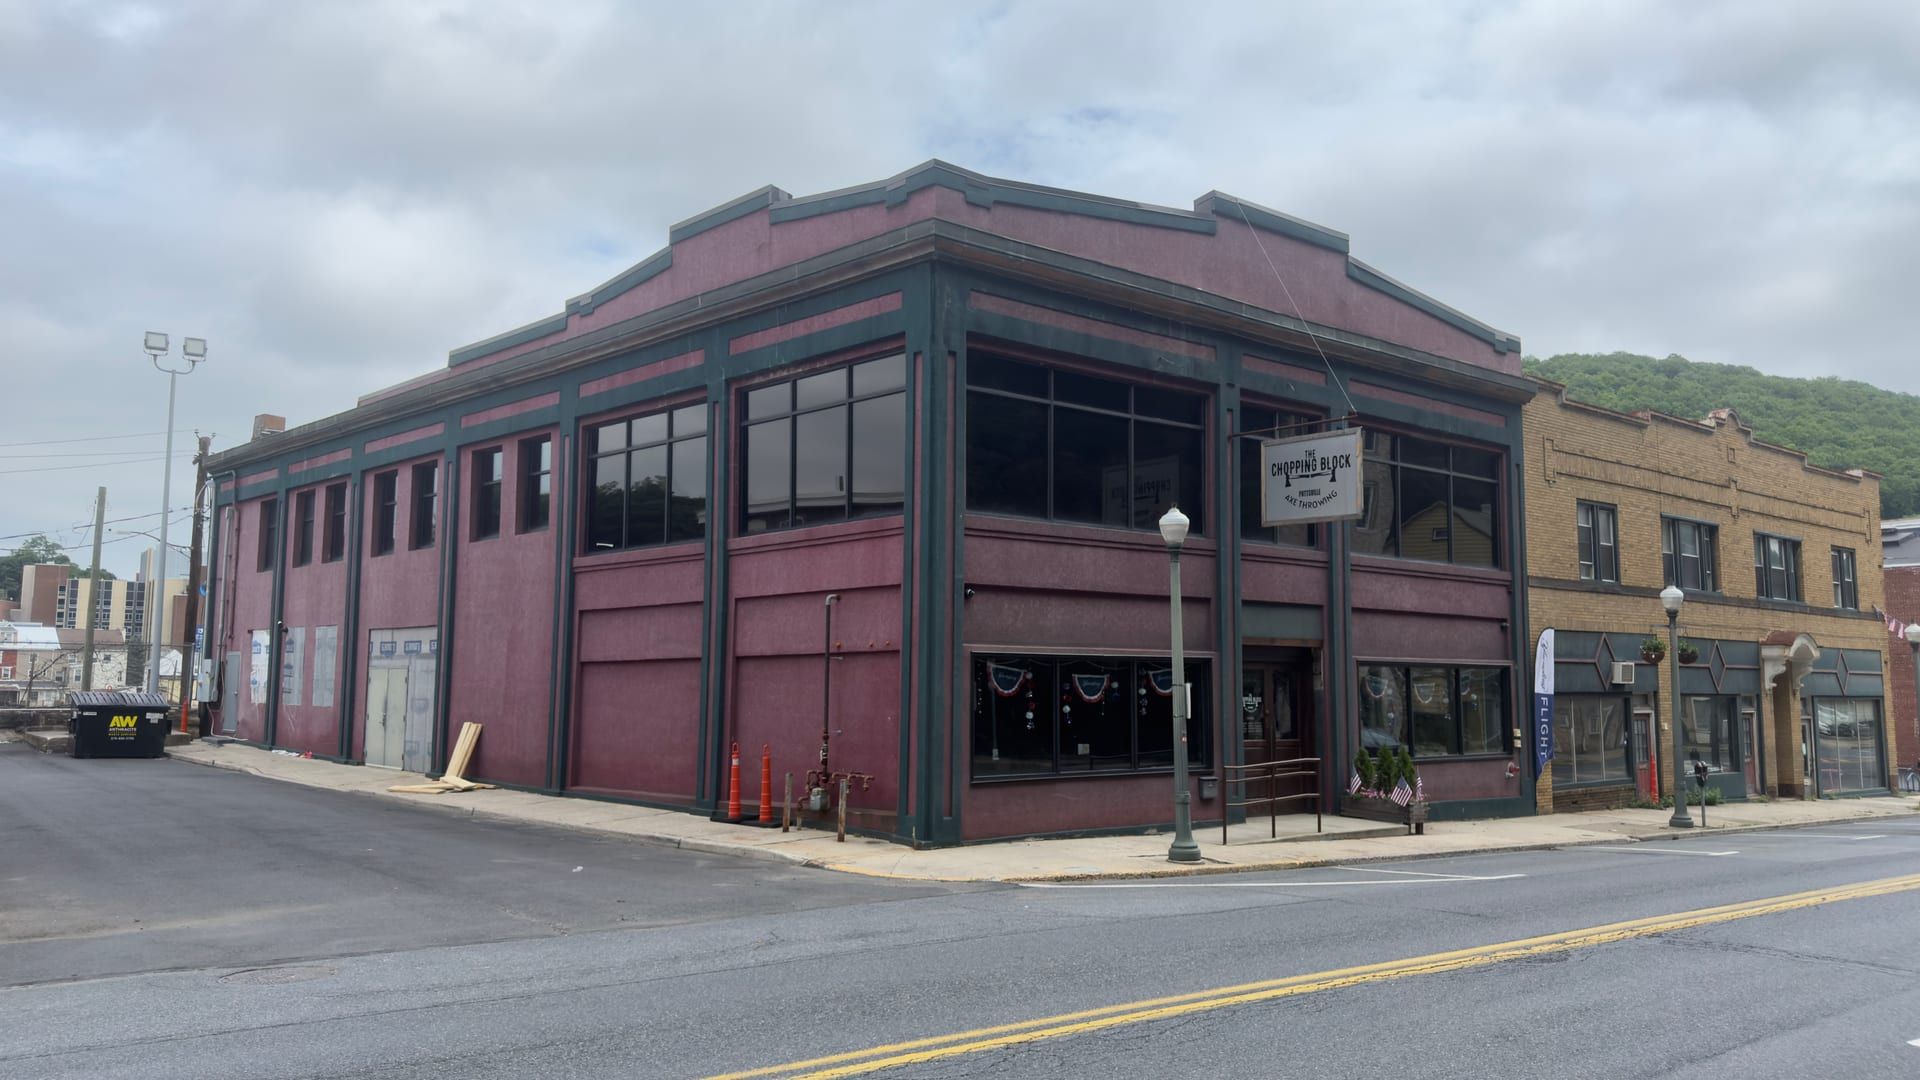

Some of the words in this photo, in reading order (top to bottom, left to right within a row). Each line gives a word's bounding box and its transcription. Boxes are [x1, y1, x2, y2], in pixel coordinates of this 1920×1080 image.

[1305, 449, 1316, 459] THE
[1271, 458, 1317, 477] CHOPPING
[1320, 453, 1351, 471] BLOCK
[1285, 494, 1298, 506] AXE
[1299, 489, 1338, 509] THROWING
[109, 715, 138, 727] AW
[1540, 696, 1549, 758] FLIGHT
